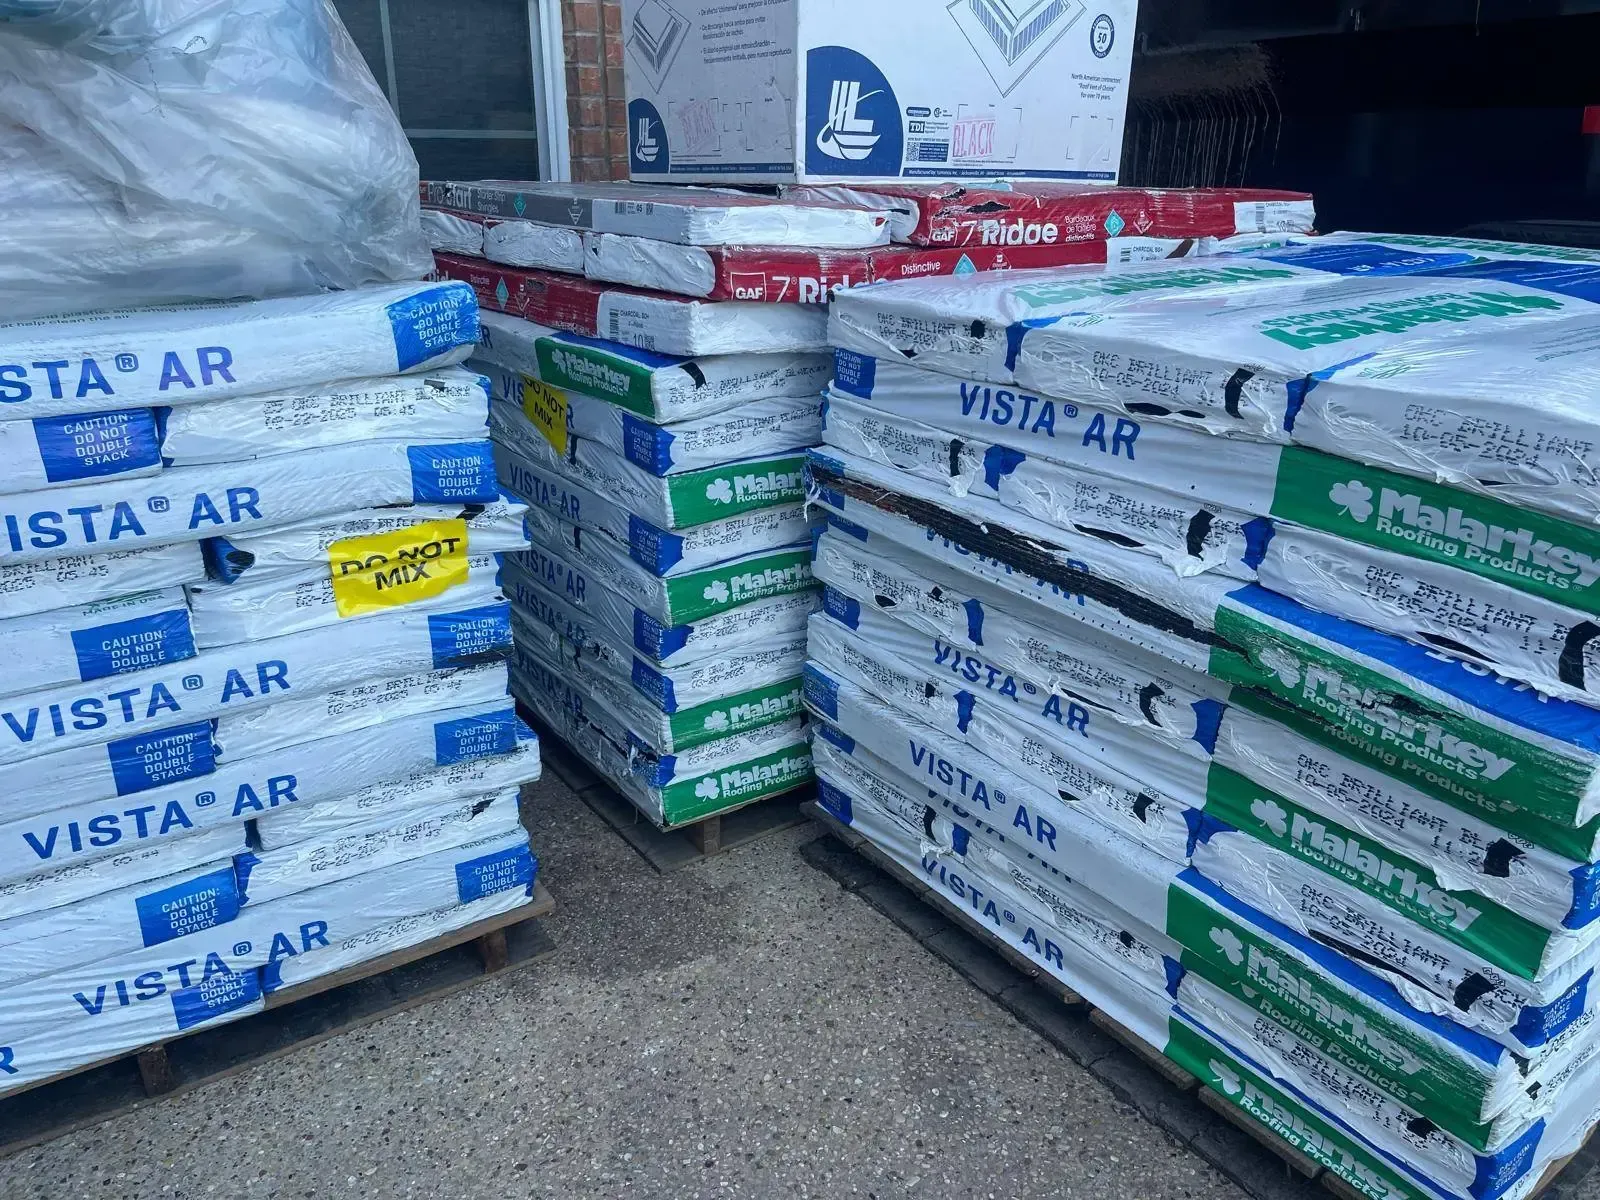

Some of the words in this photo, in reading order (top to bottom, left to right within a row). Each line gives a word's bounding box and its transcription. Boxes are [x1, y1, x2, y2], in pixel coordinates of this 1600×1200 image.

[1097, 33, 1107, 43] 50
[910, 122, 924, 132] TDI
[953, 122, 995, 157] BLACK
[931, 229, 955, 242] GAF
[961, 220, 978, 247] 7
[901, 260, 941, 276] Distinctive
[735, 287, 763, 300] GAF
[16, 319, 46, 328] help
[49, 316, 86, 324] clean
[89, 313, 113, 321] the
[418, 316, 433, 330] DO
[436, 311, 459, 322] NOT
[419, 321, 461, 340] DOUBLE
[899, 316, 957, 337] BRILLIANT
[425, 332, 459, 348] STACK
[633, 333, 644, 348] 10
[159, 346, 237, 391] AR
[565, 350, 632, 394] Malarkey
[1127, 357, 1214, 387] BRILLIANT
[534, 401, 554, 430] MIX
[543, 392, 565, 420] NOT
[63, 414, 134, 435] CAUTION:
[725, 416, 776, 432] BRILLIANT
[959, 382, 1078, 438] VISTA®
[1082, 412, 1142, 461] AR
[75, 433, 94, 446] DO
[101, 425, 129, 439] NOT
[75, 436, 133, 457] DOUBLE
[84, 450, 130, 466] STACK
[432, 456, 484, 469] CAUTION:
[438, 476, 482, 488] DOUBLE
[458, 467, 480, 475] NOT
[443, 488, 478, 497] STACK
[510, 463, 557, 508] VISTA®
[560, 490, 581, 522] AR
[733, 472, 802, 495] Malar
[188, 486, 263, 530] AR
[736, 490, 778, 504] Roofing
[725, 513, 776, 532] BRILLIANT
[1375, 516, 1461, 558] Roofing
[1378, 486, 1600, 589] Malarkey
[399, 537, 461, 563] NOT
[375, 561, 433, 591] MIX
[730, 563, 812, 594] Malark
[732, 587, 774, 602] Roofing
[102, 630, 168, 652] CAUTION:
[456, 630, 472, 641] DO
[474, 628, 495, 639] NOT
[111, 648, 130, 659] DO
[135, 641, 162, 653] NOT
[112, 650, 167, 669] DOUBLE
[1055, 650, 1127, 688] BRILLIANT
[934, 639, 1037, 703] VISTA®
[1041, 693, 1090, 739] AR
[1, 674, 204, 743] VISTA®
[221, 659, 292, 704] AR
[1301, 687, 1376, 738] Roofing
[136, 732, 199, 755] CAUTION:
[459, 741, 499, 755] DOUBLE
[460, 737, 475, 747] DO
[478, 733, 499, 744] NOT
[145, 753, 163, 763] DO
[167, 743, 193, 757] NOT
[145, 753, 196, 774] DOUBLE
[151, 765, 193, 782] STACK
[720, 755, 808, 791] Malarke
[722, 780, 763, 798] Roofing
[764, 768, 808, 787] Products
[910, 739, 1007, 811] VISTA®
[1012, 804, 1057, 852] AR
[1400, 757, 1498, 815] Products
[22, 790, 216, 860] VISTA®
[231, 774, 300, 817] AR
[482, 873, 496, 883] DO
[497, 866, 517, 878] NOT
[1290, 811, 1482, 932] Malarkey
[482, 874, 518, 892] DOUBLE
[161, 887, 221, 914] CAUTION:
[170, 908, 188, 921] DO
[191, 899, 217, 915] NOT
[1361, 876, 1450, 931] Products
[171, 908, 220, 929] DOUBLE
[920, 854, 1016, 926] VISTA®
[1021, 926, 1064, 972] AR
[177, 918, 217, 936] STACK
[73, 940, 252, 1016] VISTA®
[267, 920, 331, 962] AR
[1246, 964, 1312, 1017] Roofing
[1245, 944, 1425, 1075] Malarkey
[1258, 999, 1325, 1049] Roofing
[1326, 1037, 1409, 1101] Products
[1239, 1095, 1301, 1147] Roofing
[1303, 1142, 1382, 1200] Products
